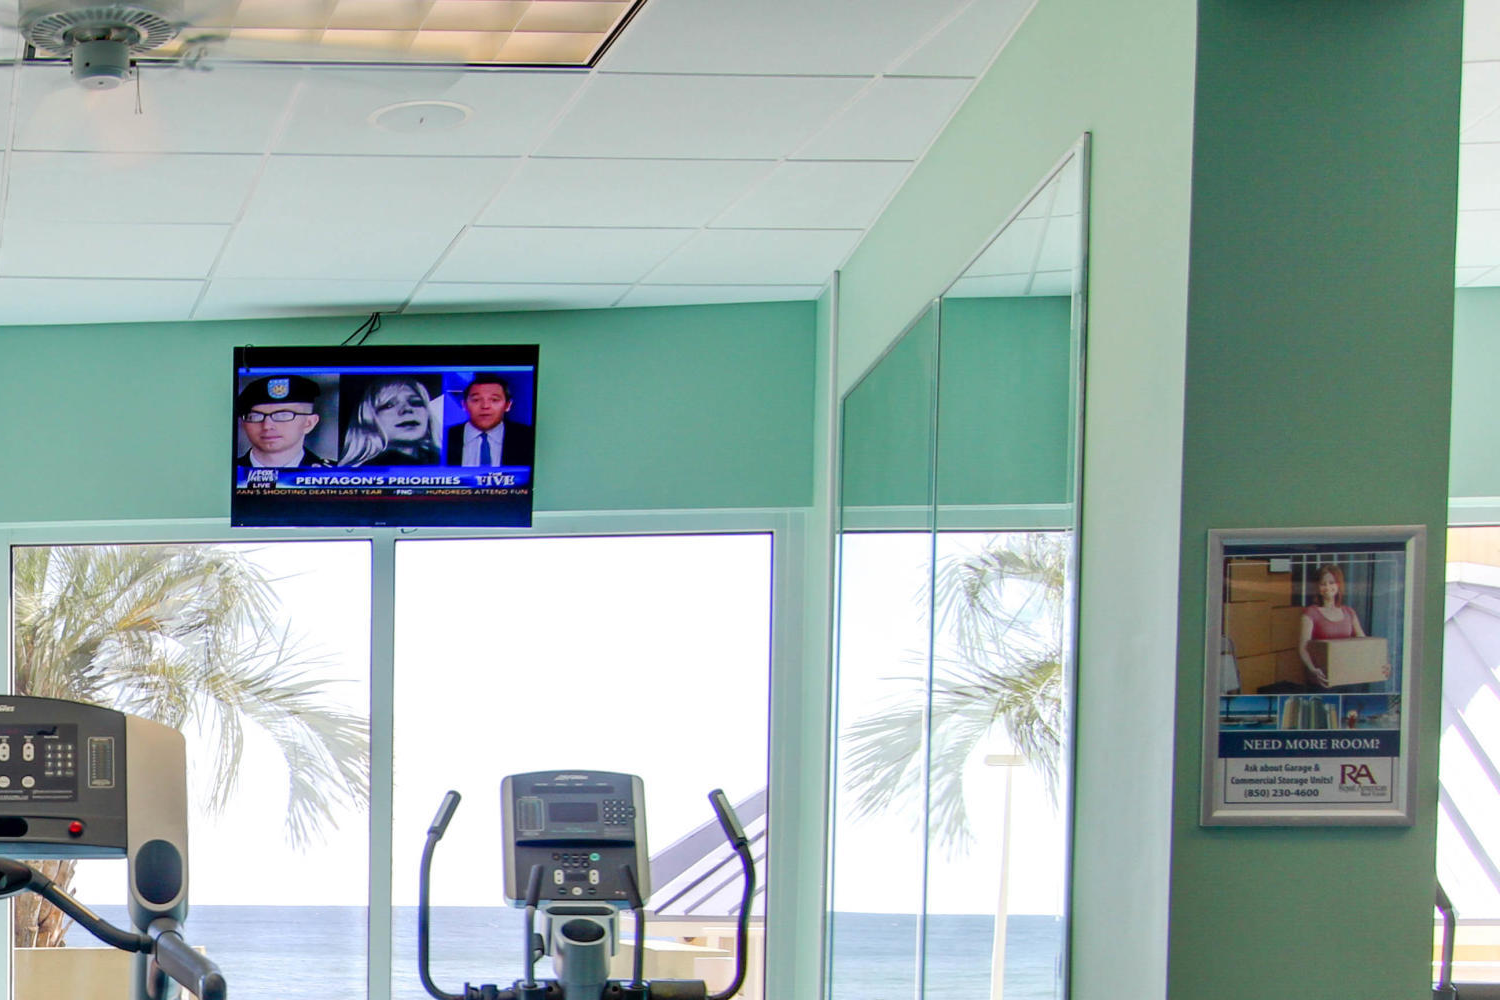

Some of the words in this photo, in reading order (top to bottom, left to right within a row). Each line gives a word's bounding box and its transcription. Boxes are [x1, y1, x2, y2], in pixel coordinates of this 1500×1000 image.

[295, 476, 385, 486] PENTAGON'S
[388, 476, 461, 485] PRIORITIES
[475, 475, 515, 486] FIVE
[1243, 739, 1282, 750] NEED
[1285, 739, 1329, 750] MORE
[1331, 738, 1381, 749] ROOM?
[1244, 764, 1258, 772] Ask
[1260, 763, 1283, 772] about
[1284, 764, 1312, 774] Garage
[1313, 764, 1320, 772] &
[1340, 764, 1377, 784] RA
[1231, 776, 1276, 785] Commercial
[1278, 776, 1309, 786] Storage
[1310, 776, 1333, 785] Units!
[1244, 788, 1270, 798] (850)
[1272, 788, 1319, 797] 230-4600
